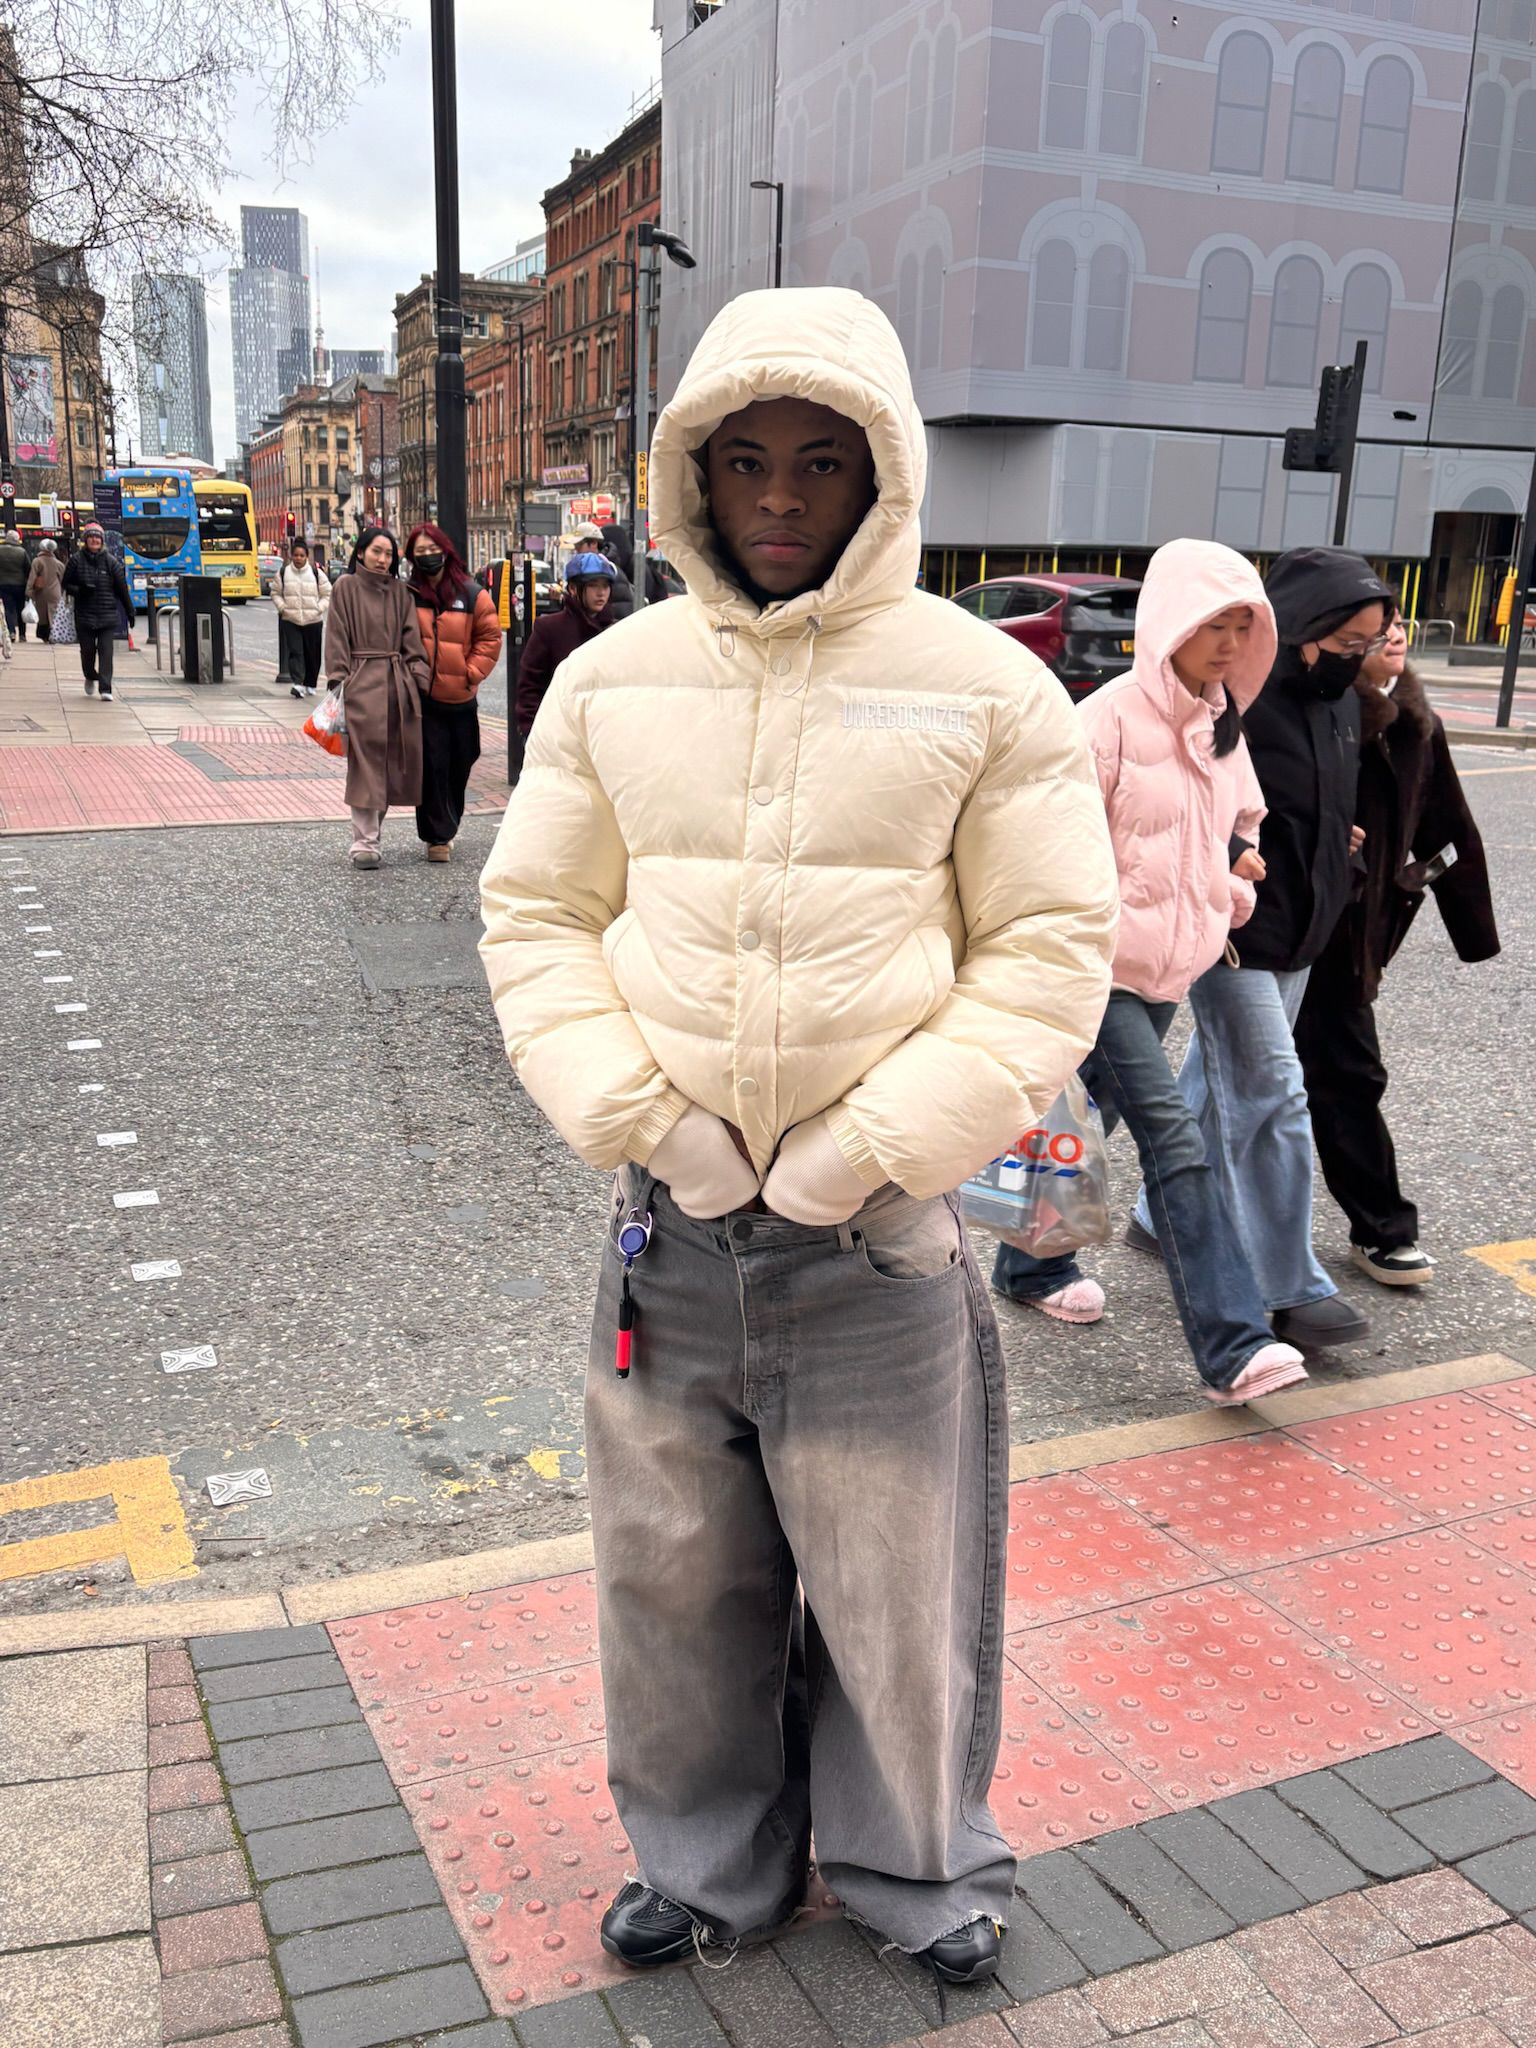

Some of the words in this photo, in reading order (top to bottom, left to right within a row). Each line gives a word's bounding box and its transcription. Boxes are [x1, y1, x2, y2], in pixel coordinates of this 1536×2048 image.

[17, 432, 53, 443] VOGUE
[638, 452, 647, 504] S01B
[842, 702, 967, 734] UNRECOGNIZED
